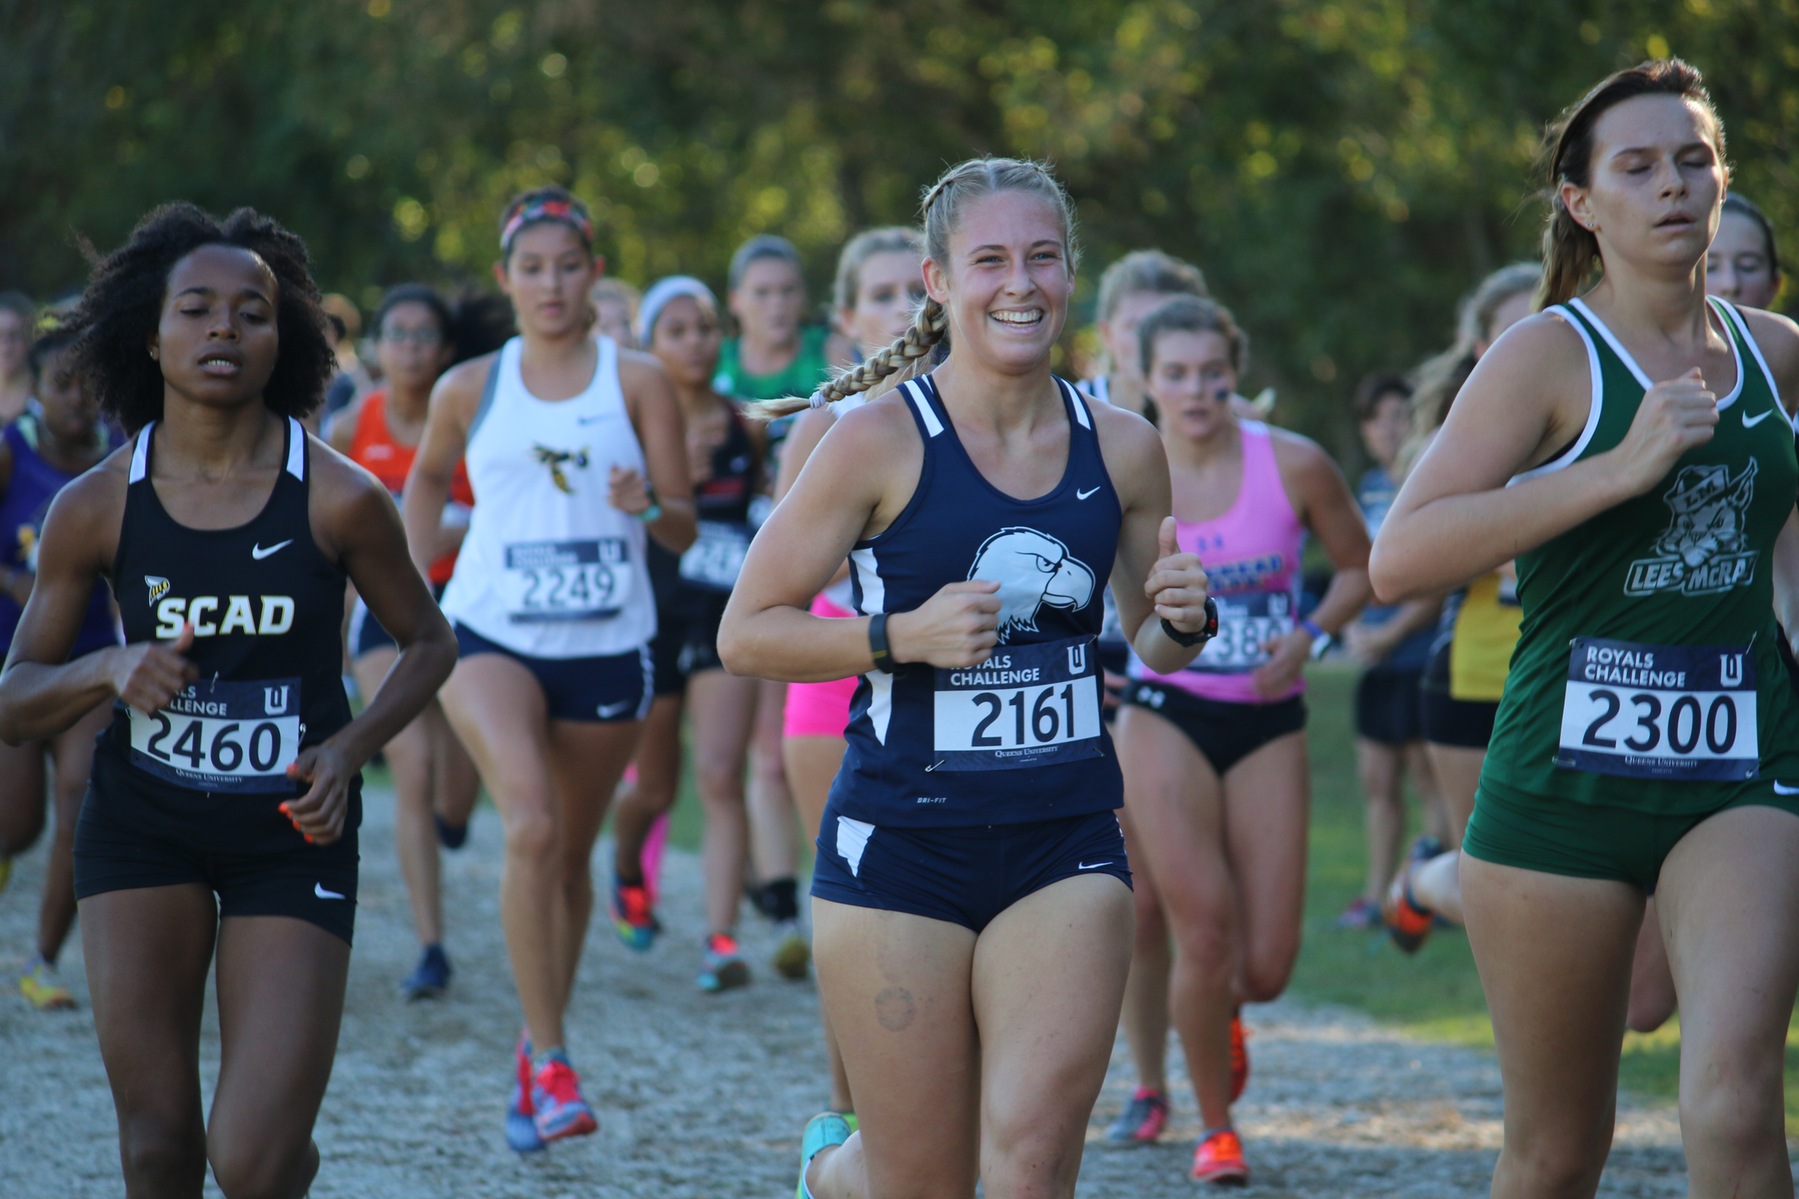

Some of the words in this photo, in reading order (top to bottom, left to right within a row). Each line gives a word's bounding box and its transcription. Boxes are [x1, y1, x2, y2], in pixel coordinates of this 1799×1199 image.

[523, 566, 615, 606] 2249
[156, 594, 295, 639] SCAD
[950, 667, 1040, 686] CHALLENGE
[1584, 665, 1686, 688] CHALLENGE
[1587, 646, 1653, 669] ROYALS
[168, 698, 227, 717] LLENGE
[971, 683, 1075, 747] 2161
[1582, 689, 1737, 755] 2300
[147, 713, 281, 772] 2460
